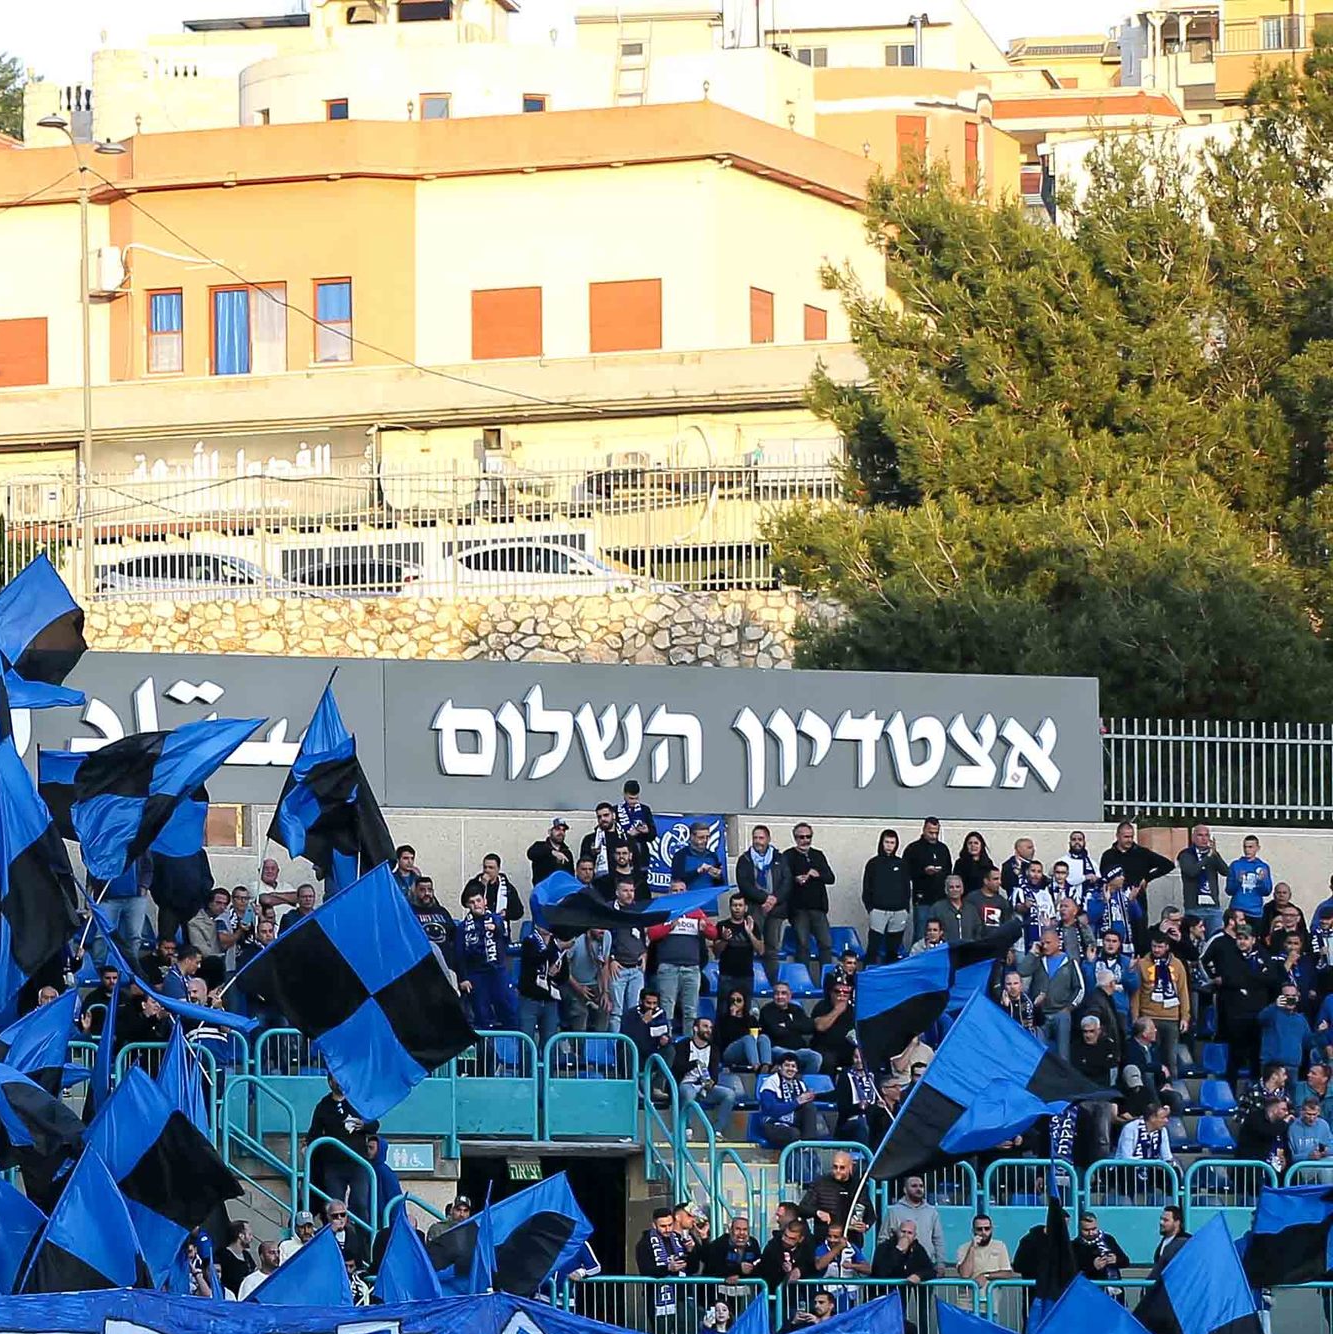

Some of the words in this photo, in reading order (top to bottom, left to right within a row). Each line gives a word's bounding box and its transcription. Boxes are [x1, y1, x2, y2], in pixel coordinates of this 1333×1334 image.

[432, 686, 704, 783] השלום
[732, 706, 1061, 809] אצטדיון
[509, 1164, 541, 1179] יציאה
